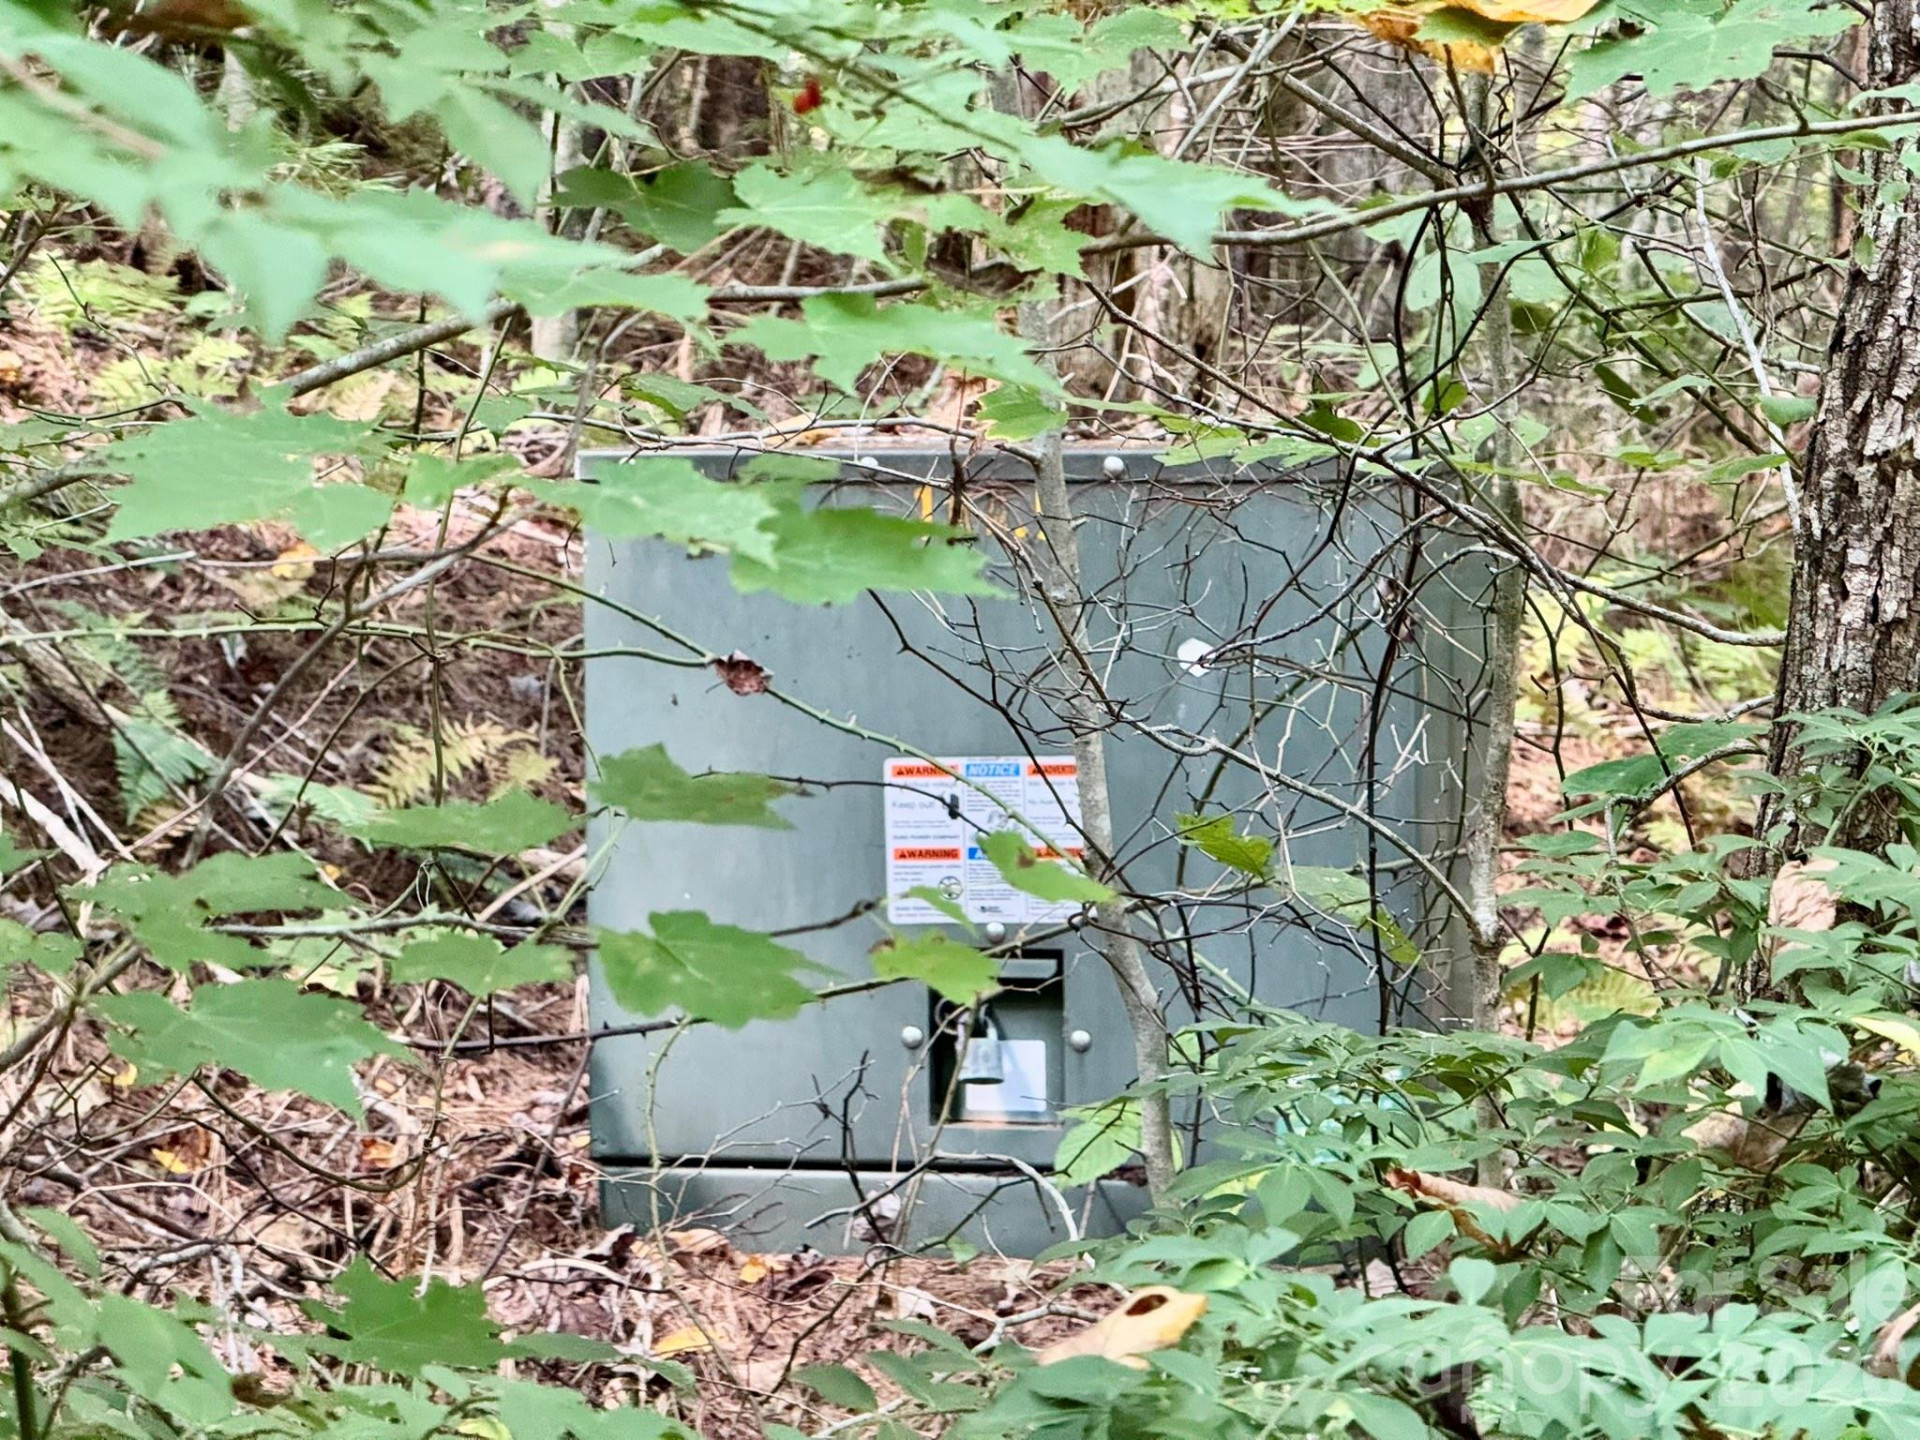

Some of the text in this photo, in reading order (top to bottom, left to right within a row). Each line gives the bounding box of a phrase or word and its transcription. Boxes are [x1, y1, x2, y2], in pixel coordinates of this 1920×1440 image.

[904, 766, 957, 776] WARN
[968, 764, 1018, 775] NOTICE
[906, 849, 959, 859] WARNING
